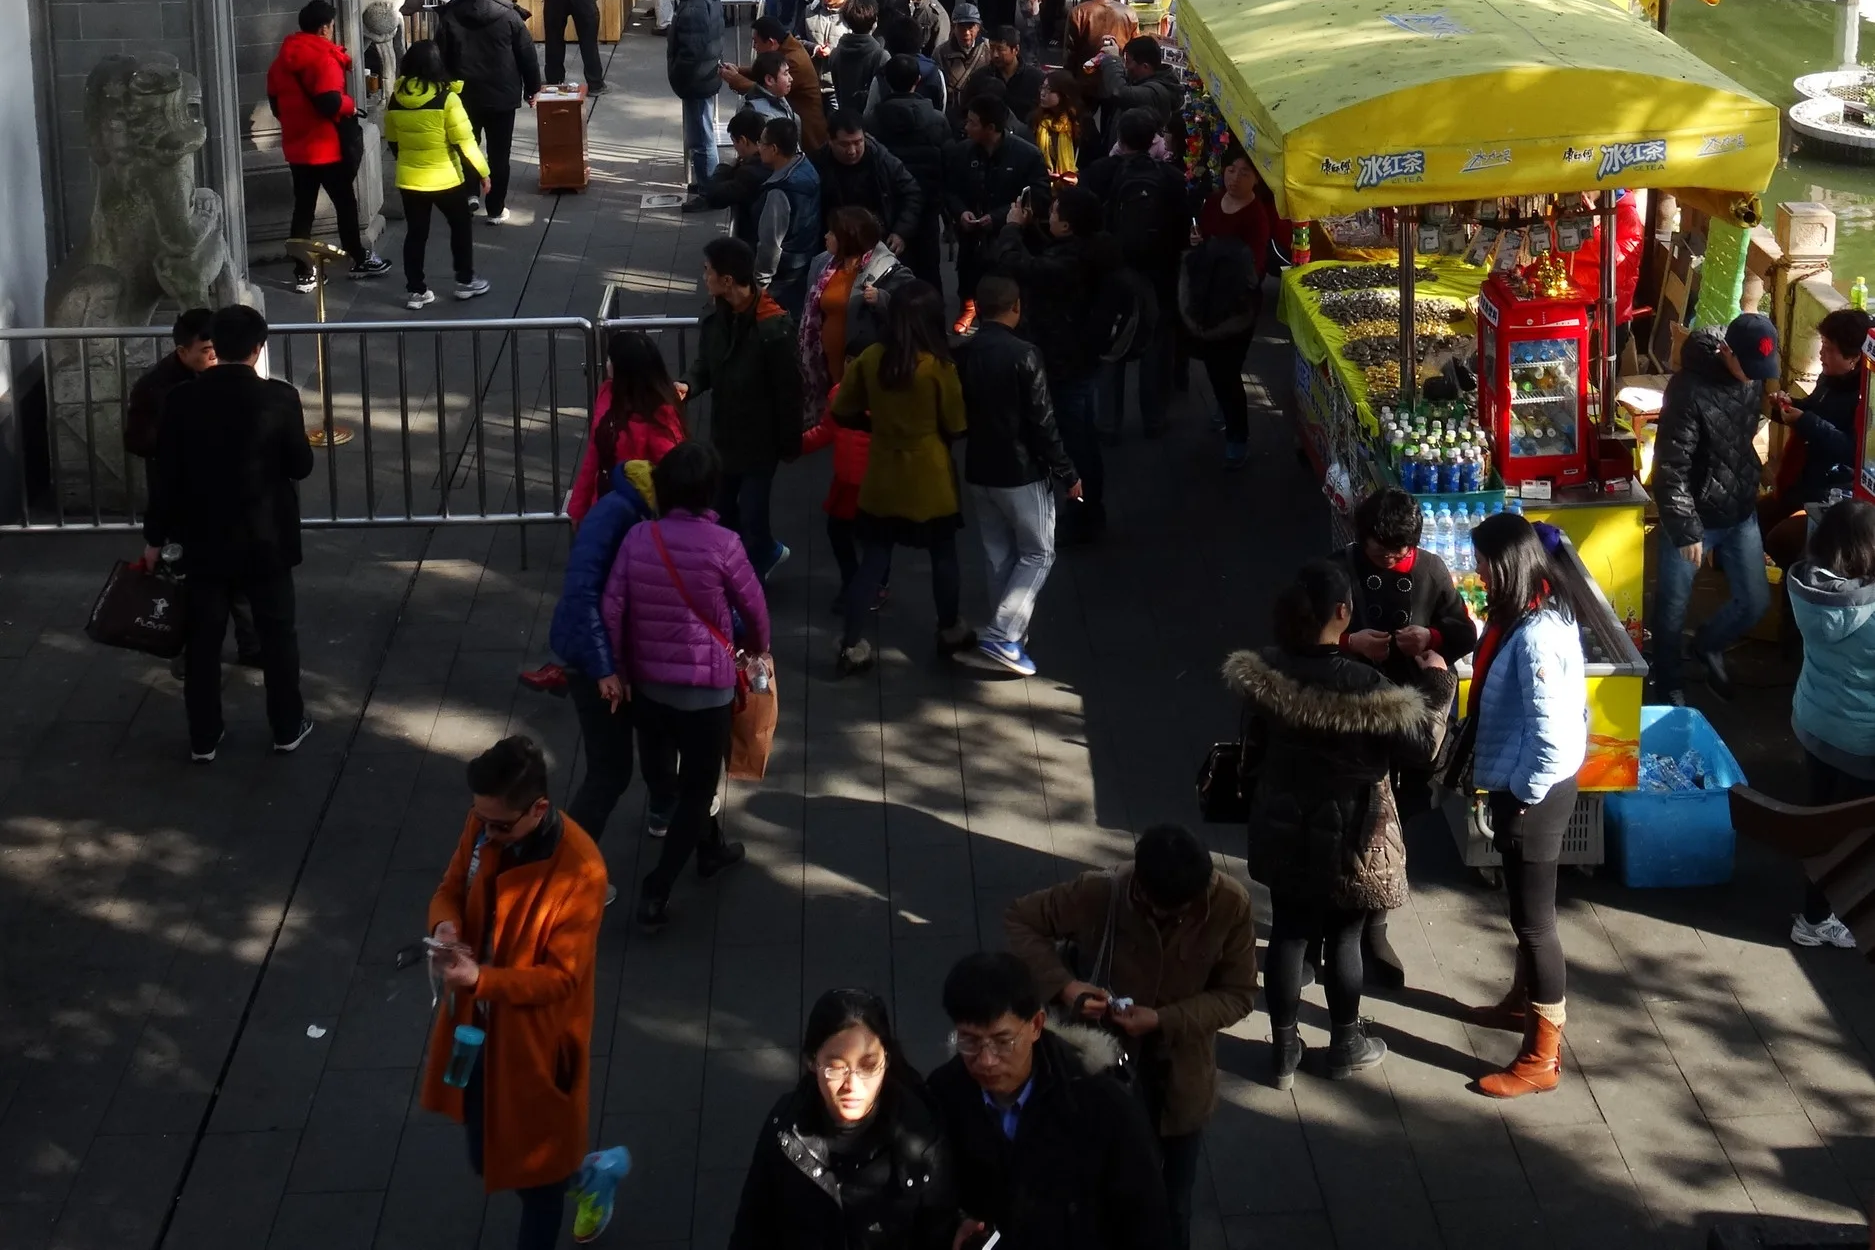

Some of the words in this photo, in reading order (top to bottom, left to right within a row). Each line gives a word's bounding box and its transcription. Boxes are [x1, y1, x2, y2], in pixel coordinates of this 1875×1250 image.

[1355, 151, 1425, 191] 冰红茶
[1597, 140, 1667, 180] 冰红茶
